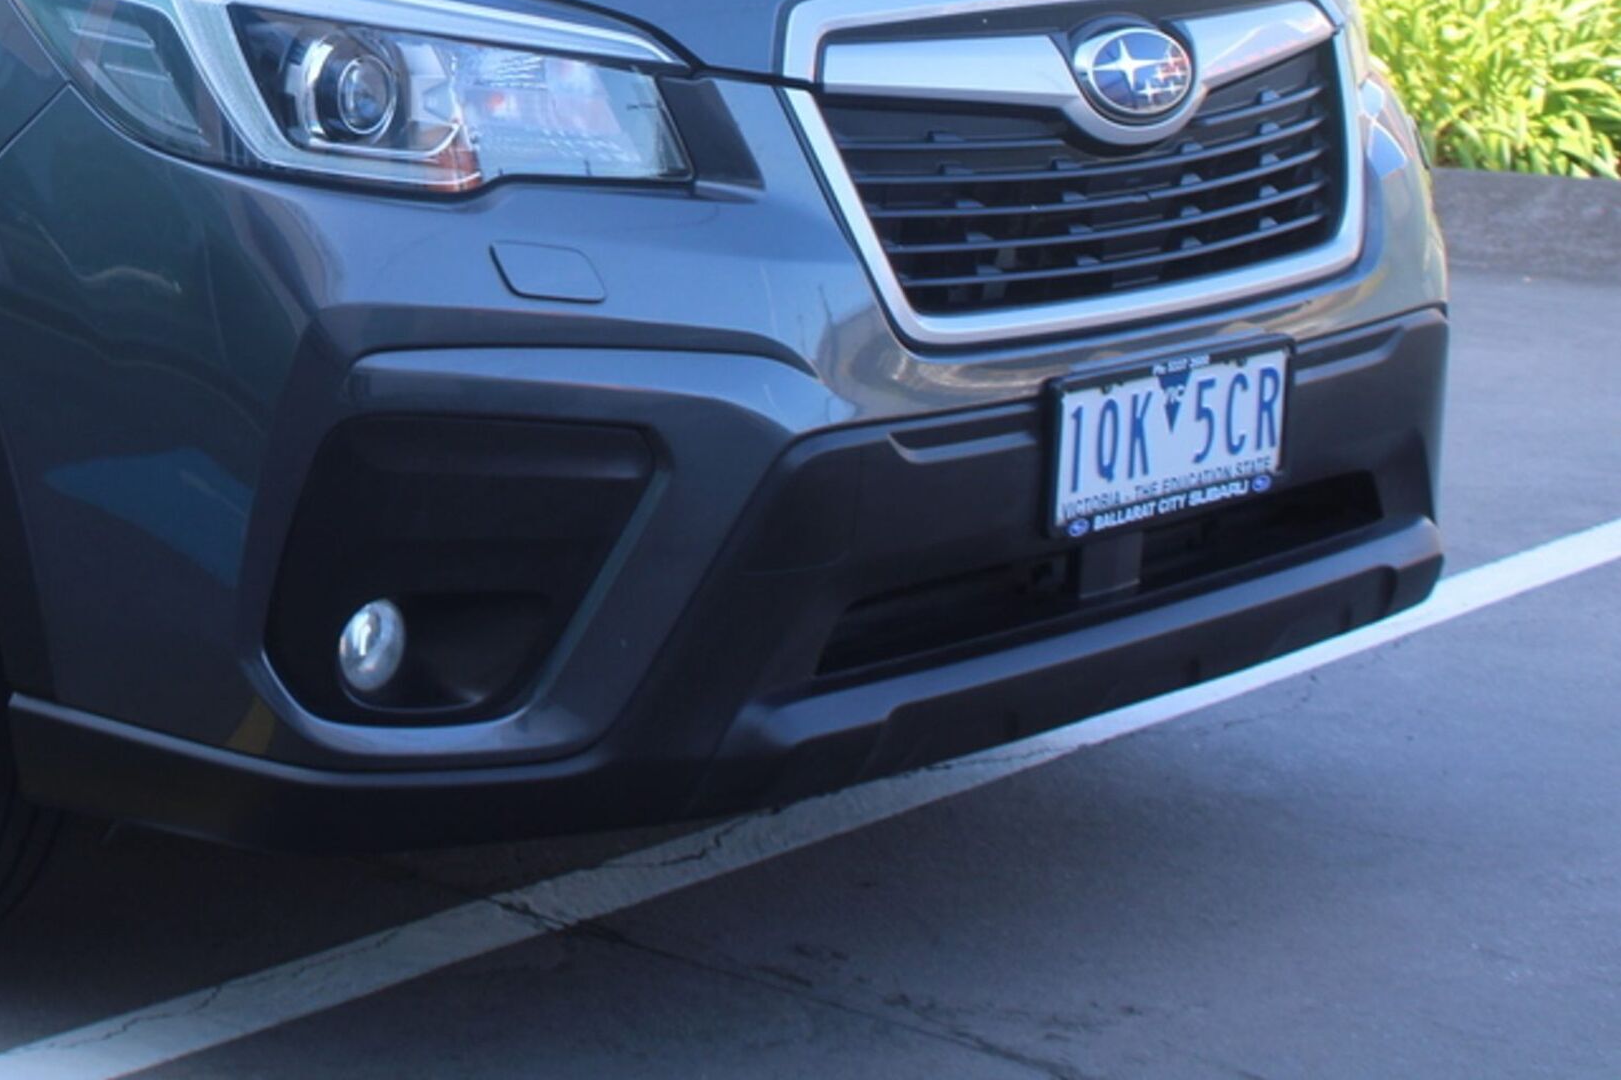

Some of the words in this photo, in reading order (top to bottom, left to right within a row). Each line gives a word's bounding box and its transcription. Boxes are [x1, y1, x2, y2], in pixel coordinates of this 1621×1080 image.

[1071, 391, 1153, 493] 1QK
[1192, 366, 1280, 464] 5CR
[1062, 490, 1122, 518] VICTORIA
[1135, 481, 1158, 498] THE
[1163, 465, 1233, 492] EDUCATION
[1235, 456, 1272, 478] STATE
[1093, 502, 1156, 531] BALLARAT
[1158, 493, 1186, 515] CITY
[1188, 480, 1250, 507] SUBARU
